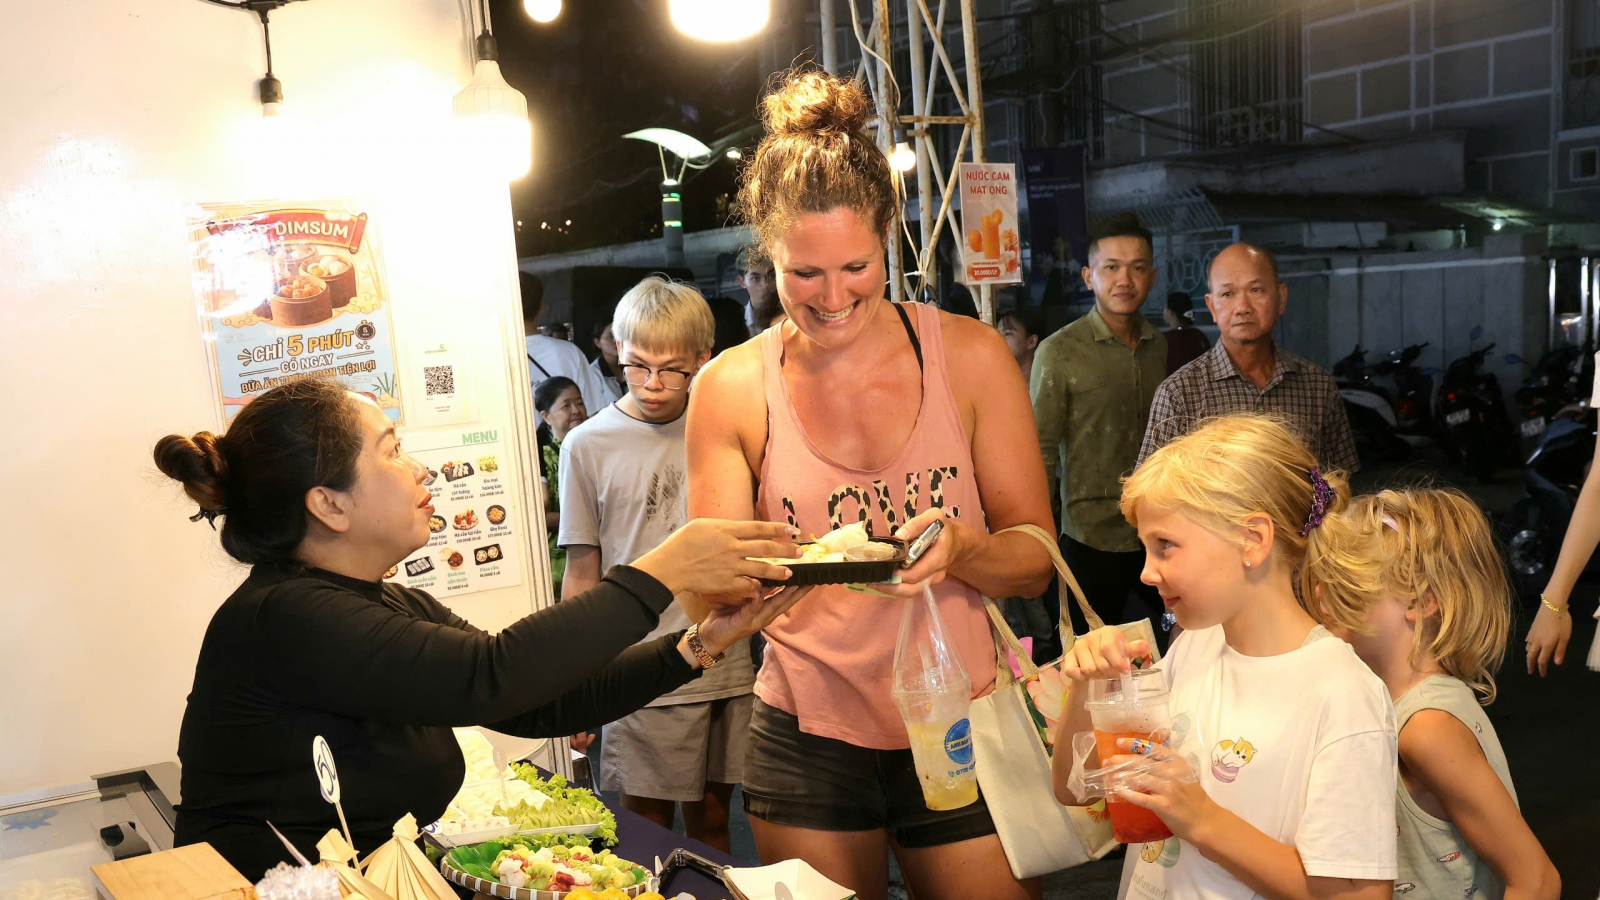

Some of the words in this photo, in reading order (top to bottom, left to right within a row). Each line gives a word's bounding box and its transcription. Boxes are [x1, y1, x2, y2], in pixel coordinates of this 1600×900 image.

[966, 171, 989, 181] NƯỚC
[991, 172, 1010, 181] CAM
[989, 186, 1007, 195] ONG
[275, 221, 349, 239] DIMSUM
[253, 338, 284, 362] CHỈ
[287, 334, 303, 356] 5
[308, 329, 354, 353] PHÚT
[280, 357, 298, 372] CÓ
[301, 353, 334, 370] NGAY
[241, 379, 263, 393] BỮA
[264, 376, 278, 389] ĂN
[338, 363, 360, 377] TIỆN
[361, 360, 376, 373] LỢI
[462, 430, 497, 444] MENU
